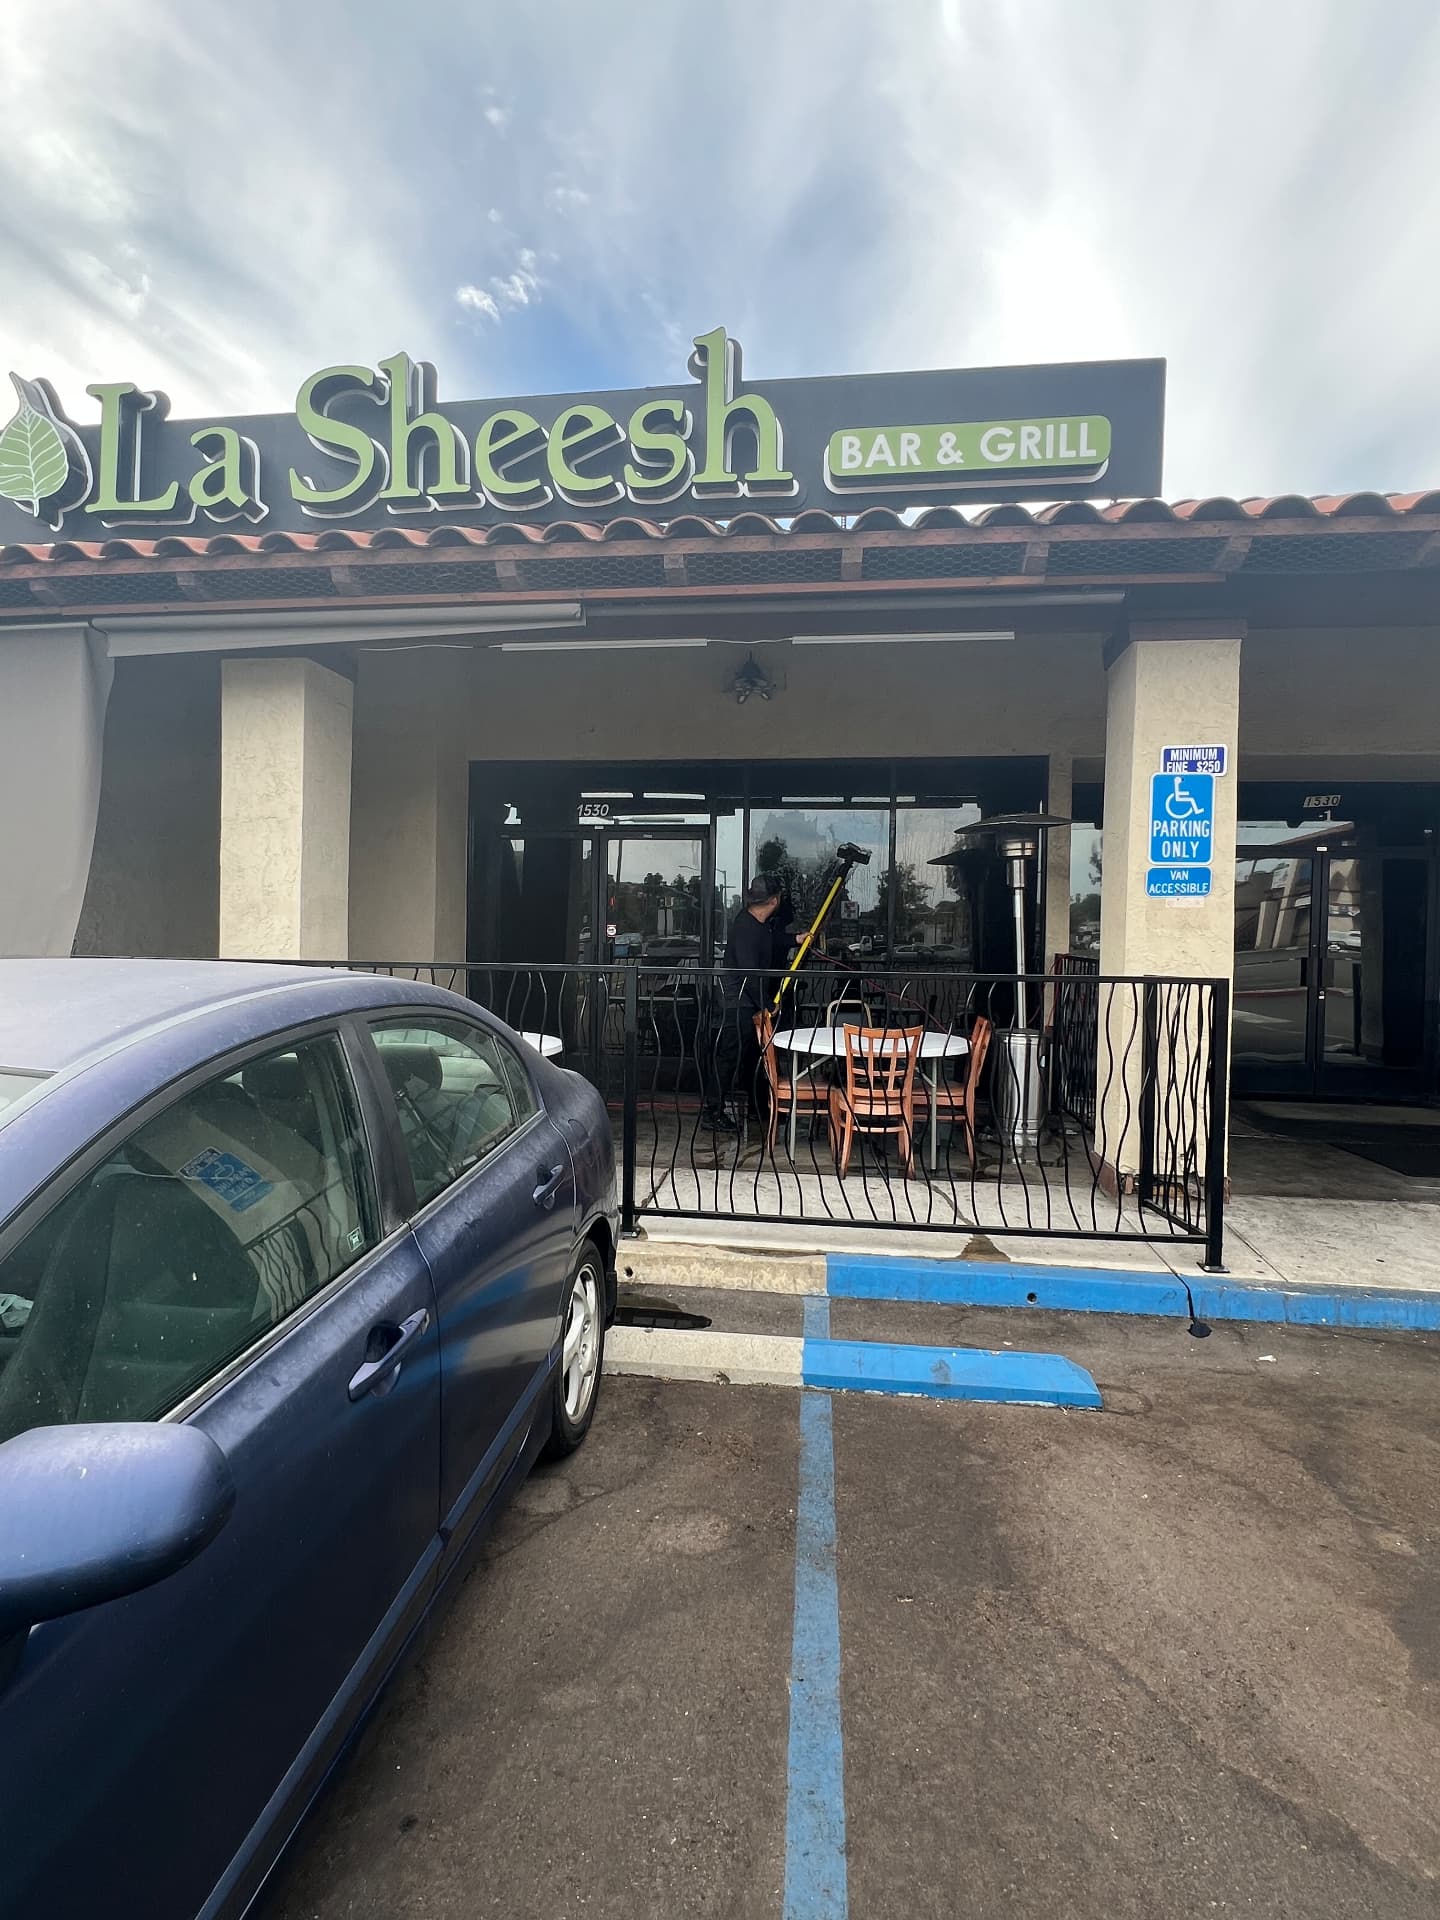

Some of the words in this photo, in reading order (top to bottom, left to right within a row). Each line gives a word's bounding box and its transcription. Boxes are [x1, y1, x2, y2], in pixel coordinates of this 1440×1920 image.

[85, 381, 250, 513] La
[289, 326, 793, 503] Sheesh
[841, 432, 921, 469] BAR
[936, 431, 964, 465] &
[980, 422, 1097, 462] GRILL
[1170, 748, 1217, 761] MINIMUM
[1166, 761, 1188, 772] FINE
[1196, 760, 1220, 772] $250
[1304, 795, 1340, 807] 1530
[577, 804, 609, 817] 1530
[1153, 820, 1210, 838] PARKING
[1162, 840, 1199, 858] ONLY
[1170, 870, 1189, 880] VAN
[1149, 882, 1209, 894] ACCESSIBLE
